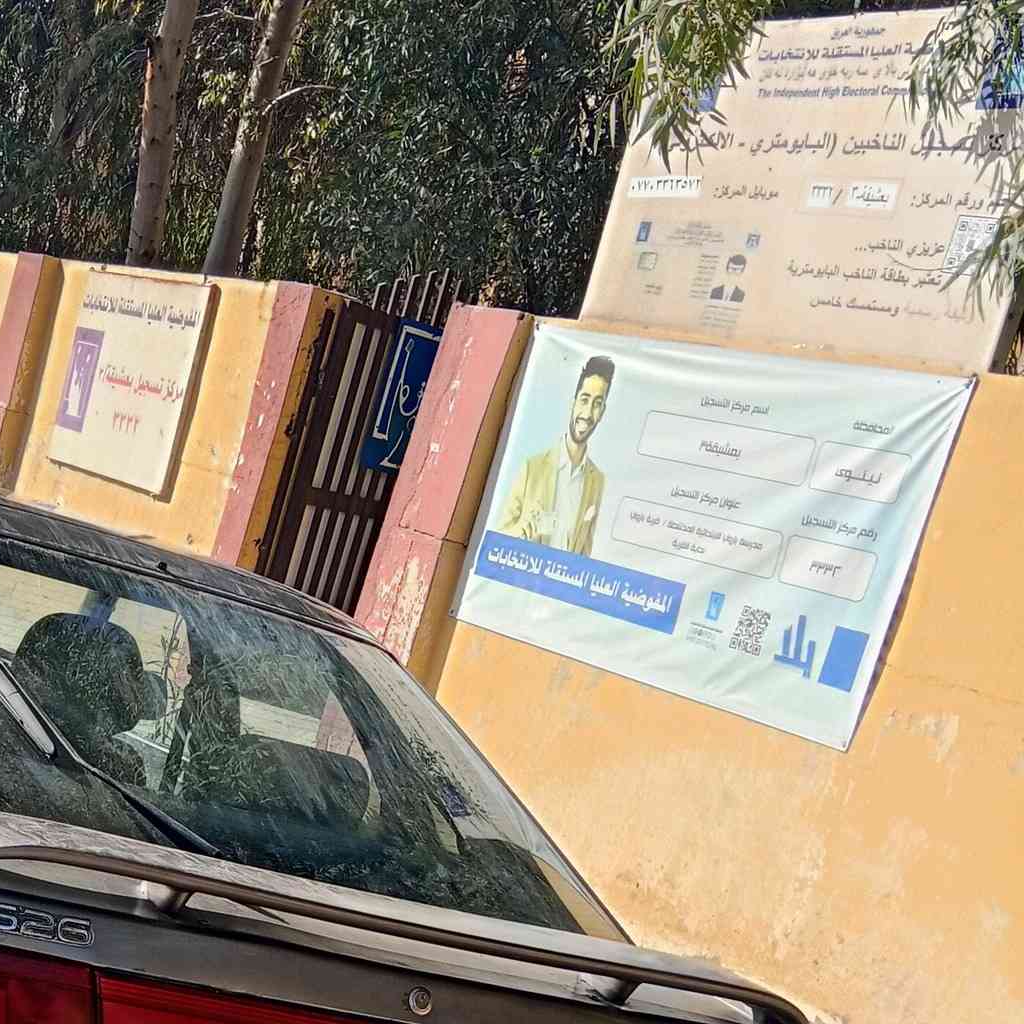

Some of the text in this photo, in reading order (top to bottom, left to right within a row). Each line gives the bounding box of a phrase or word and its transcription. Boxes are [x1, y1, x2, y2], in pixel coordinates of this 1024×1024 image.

[758, 47, 820, 64] للانتخابات
[822, 45, 868, 59] المستقلة
[870, 43, 902, 61] العليا
[758, 88, 772, 98] The
[773, 86, 820, 99] Independent
[822, 85, 841, 99] High
[842, 84, 880, 98] Electoral
[842, 132, 906, 156] الناخبين
[749, 185, 779, 200] موبايل
[906, 241, 945, 258] عزيزي
[844, 266, 877, 281] الناخب
[880, 270, 909, 287] بطاقة
[837, 522, 857, 536] مركز
[857, 527, 878, 542] رقم
[487, 546, 673, 614] المفوضية العليا المستقلة للانتخابات
